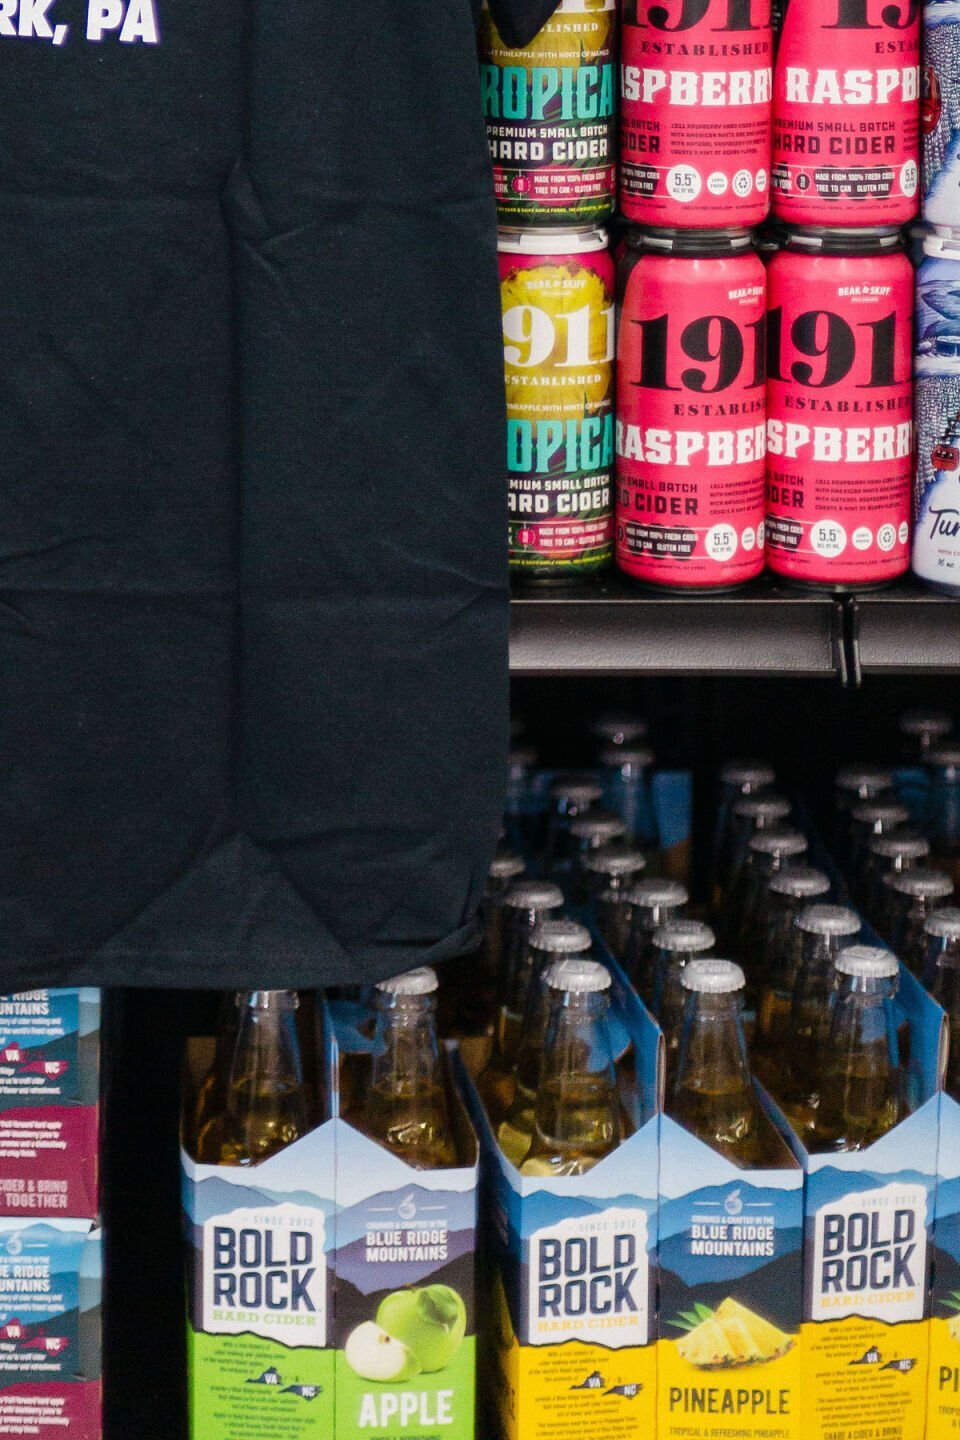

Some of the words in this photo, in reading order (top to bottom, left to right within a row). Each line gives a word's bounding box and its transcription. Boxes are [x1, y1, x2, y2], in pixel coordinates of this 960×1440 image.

[640, 40, 769, 57] ESTABLISHED
[786, 66, 920, 105] RASPB
[486, 125, 537, 138] PREMIUM
[540, 127, 578, 138] SMALL
[581, 124, 608, 136] BATCH
[817, 121, 856, 132] SMALL
[859, 121, 896, 131] BATCH
[488, 140, 545, 160] HARD
[552, 138, 608, 160] CIDER
[773, 133, 821, 154] HARD
[829, 135, 896, 155] CIDER
[766, 304, 913, 389] 191
[366, 1232, 402, 1246] BLUE
[407, 1230, 448, 1245] RIDGE
[691, 1225, 728, 1241] BLUE
[732, 1224, 774, 1241] RIDGE
[823, 1209, 915, 1258] BOLD
[214, 1226, 313, 1270] BOLD
[366, 1245, 448, 1263] MOUNTAINS
[538, 1233, 636, 1282] BOLD
[691, 1240, 774, 1257] MOUNTAINS
[821, 1243, 917, 1294] ROCK
[213, 1268, 317, 1312] ROCK
[538, 1268, 639, 1318] ROCK
[212, 1309, 260, 1322] HARD
[263, 1312, 317, 1326] CIDER
[359, 1389, 454, 1429] APPLE
[669, 1386, 791, 1416] PINEAPPLE
